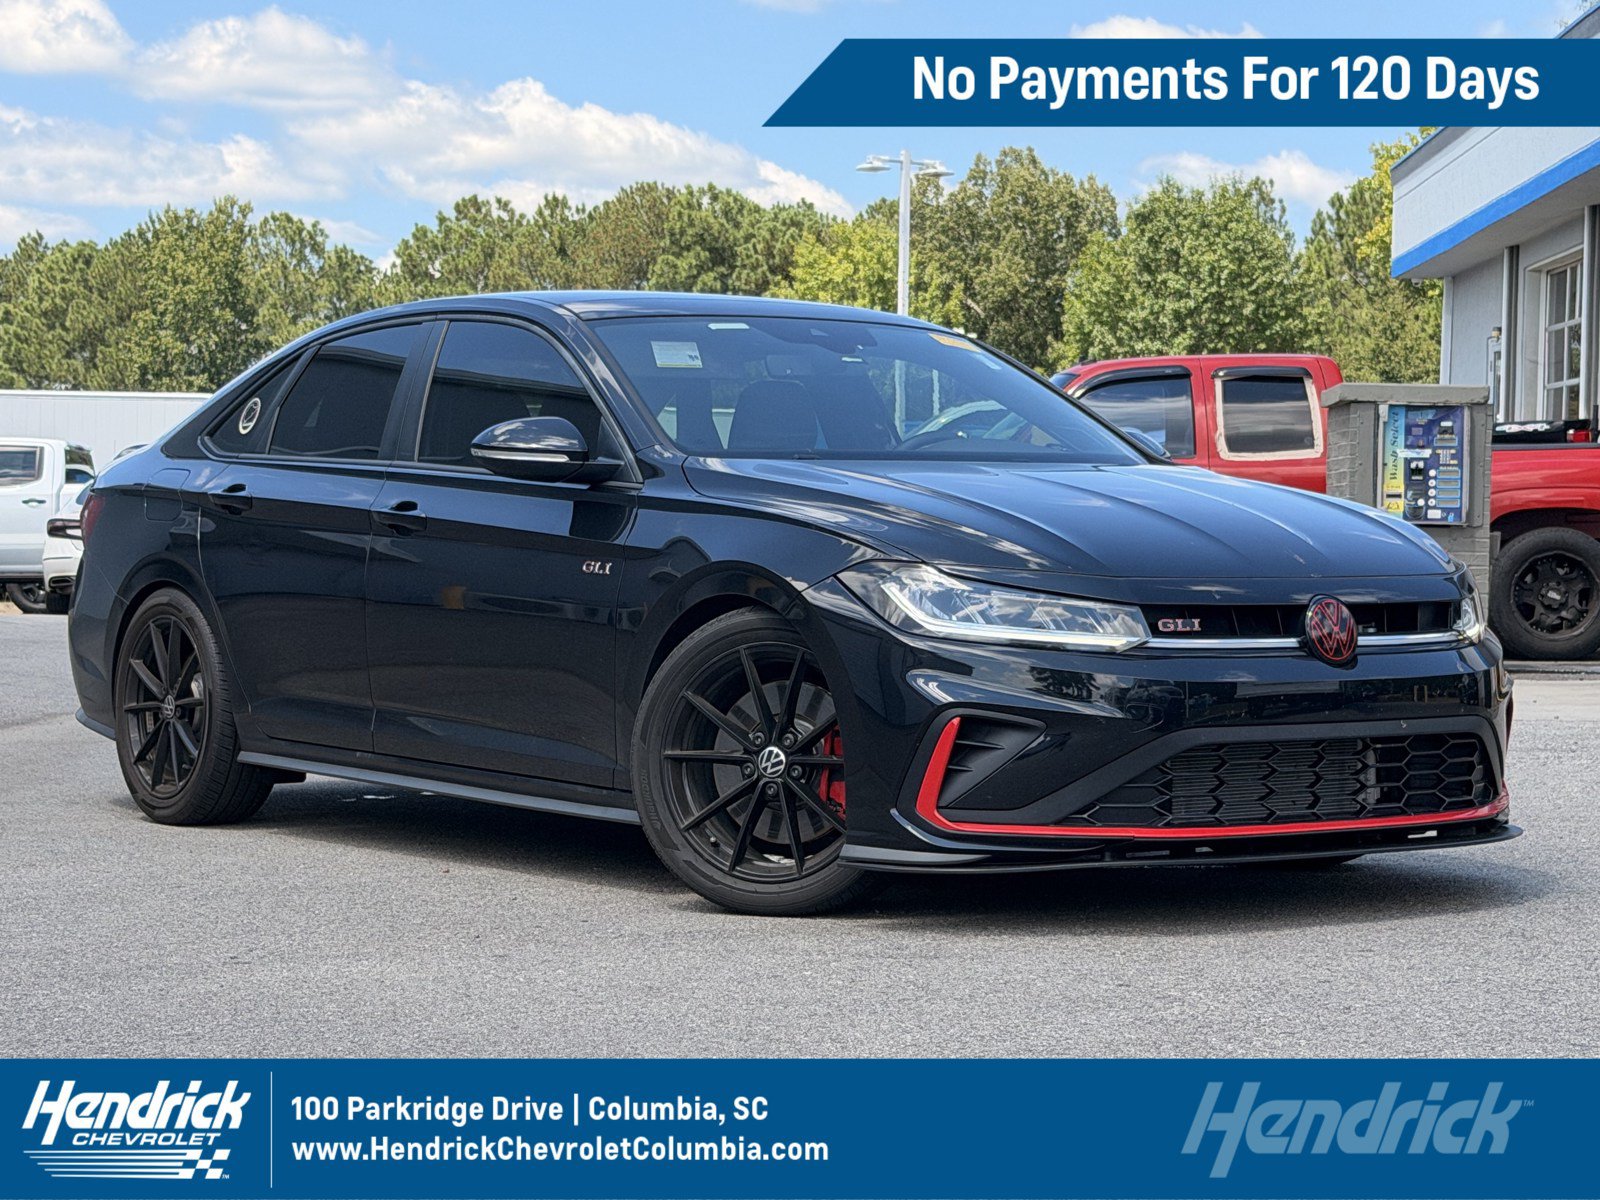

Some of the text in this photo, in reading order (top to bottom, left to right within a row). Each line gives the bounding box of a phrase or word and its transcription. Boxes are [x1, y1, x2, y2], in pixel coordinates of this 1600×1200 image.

[1390, 411, 1399, 447] Select
[1389, 450, 1399, 480] Wash
[582, 560, 612, 575] GLI
[1157, 618, 1202, 632] GLI
